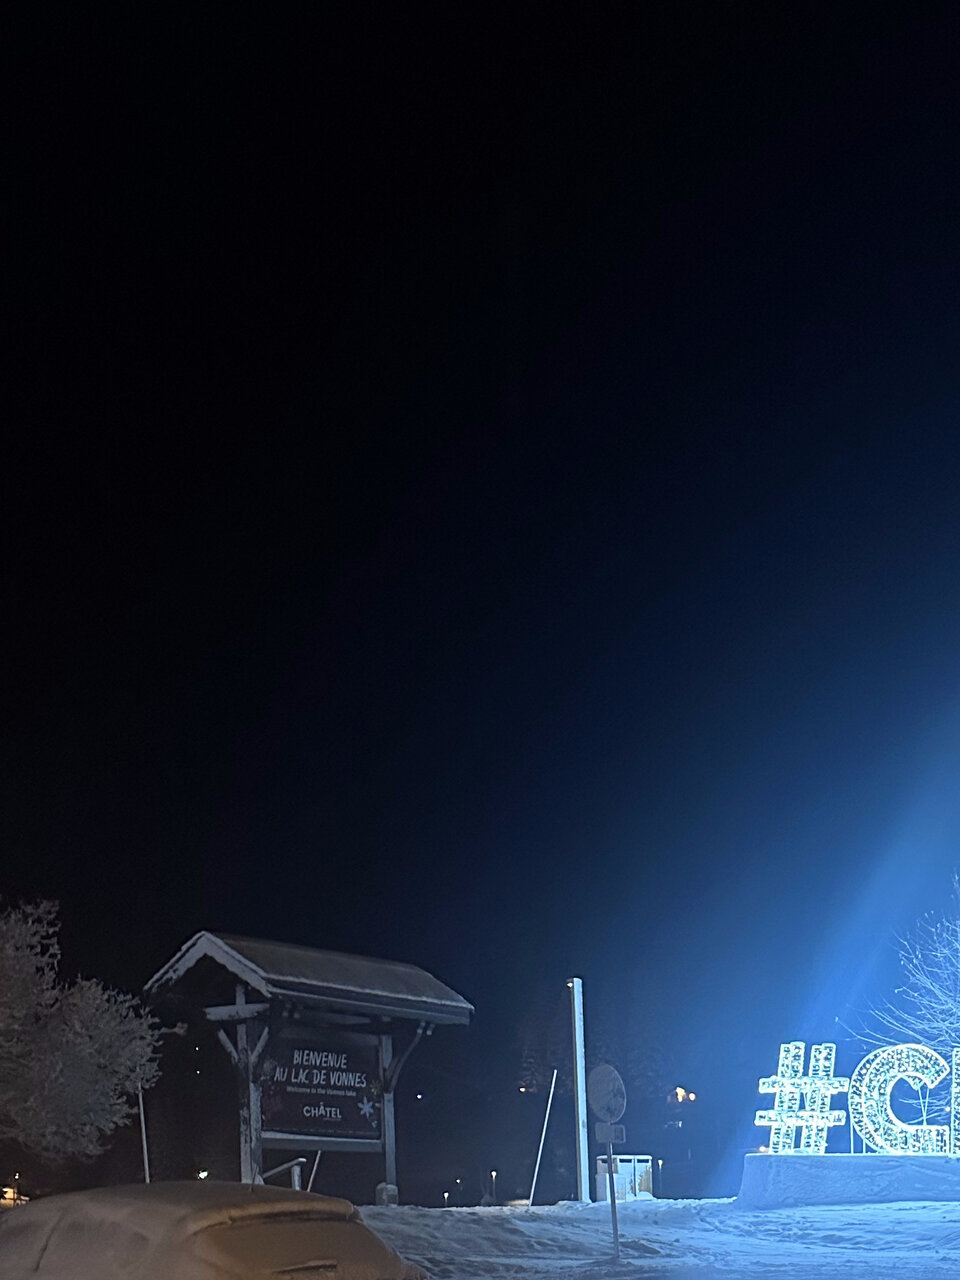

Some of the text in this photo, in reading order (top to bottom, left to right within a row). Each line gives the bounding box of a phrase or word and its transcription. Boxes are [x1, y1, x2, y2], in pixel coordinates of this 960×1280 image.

[293, 1049, 348, 1069] BIENVENUE
[274, 1066, 367, 1088] AU LAC DE VONNES
[303, 1101, 342, 1118] CHÂTEL
